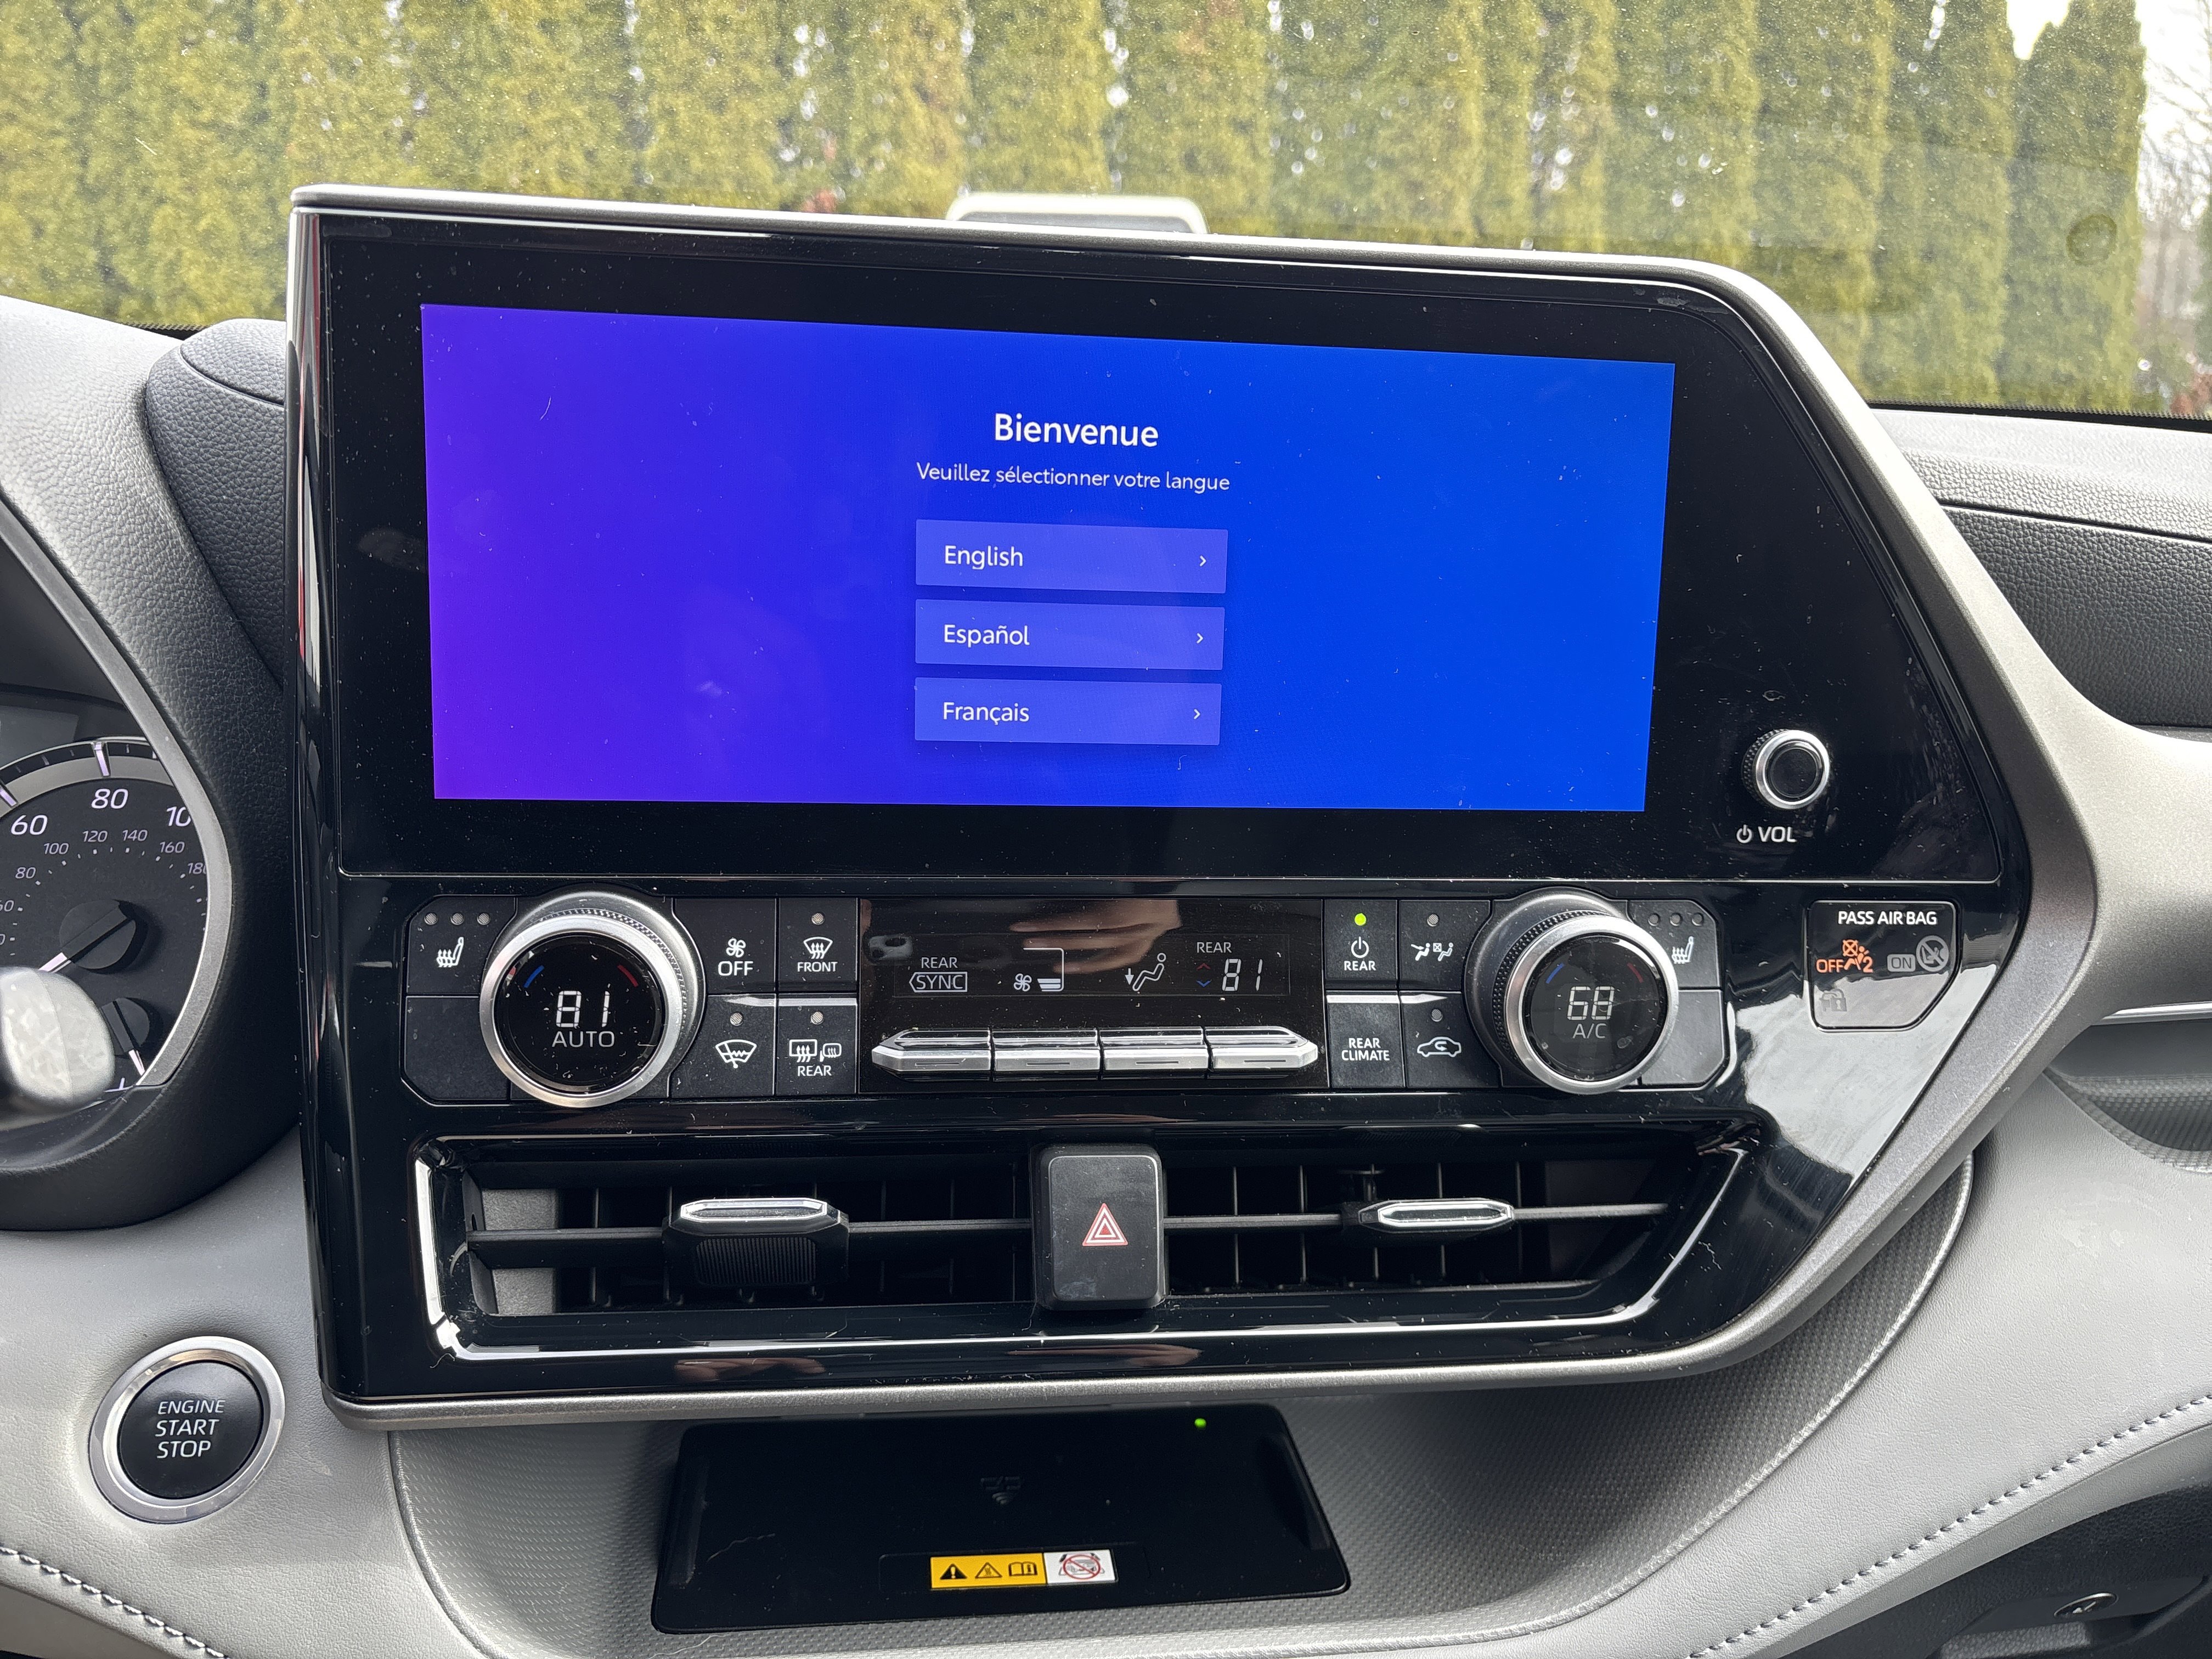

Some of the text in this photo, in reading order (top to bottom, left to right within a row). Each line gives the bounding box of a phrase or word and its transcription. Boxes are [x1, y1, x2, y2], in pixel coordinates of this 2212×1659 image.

[994, 413, 1159, 447] Bienvenue
[917, 462, 1229, 493] Veuillez sélectionner votre langue
[944, 545, 1024, 569] English
[944, 624, 1030, 647] Español
[943, 702, 1029, 725] Français
[91, 788, 128, 809] 80
[10, 815, 48, 836] 60
[82, 830, 108, 842] 120
[122, 830, 148, 842] 140
[1758, 827, 1797, 842] VOL
[43, 842, 69, 855] 100
[160, 842, 185, 853] 160
[15, 867, 36, 879] 80
[1838, 911, 1937, 925] PASS AIR BAG
[1197, 941, 1232, 953] REAR
[718, 961, 753, 976] OFF
[797, 961, 837, 973] FRONT
[921, 957, 958, 969] REAR
[1344, 960, 1376, 972] REAR
[1816, 959, 1843, 973] OFF
[1891, 957, 1911, 969] ON
[917, 974, 963, 990] SYNC
[1222, 958, 1263, 992] 81
[555, 990, 612, 1028] 81
[1567, 986, 1615, 1022] 68
[1572, 1024, 1606, 1039] A/C
[551, 1031, 614, 1048] AUTO
[1348, 1037, 1381, 1049] REAR
[1341, 1049, 1390, 1062] CLIMATE
[797, 1065, 832, 1076] REAR
[158, 1400, 225, 1415] ENGINE
[155, 1419, 220, 1437] START
[156, 1441, 211, 1459] STOP
